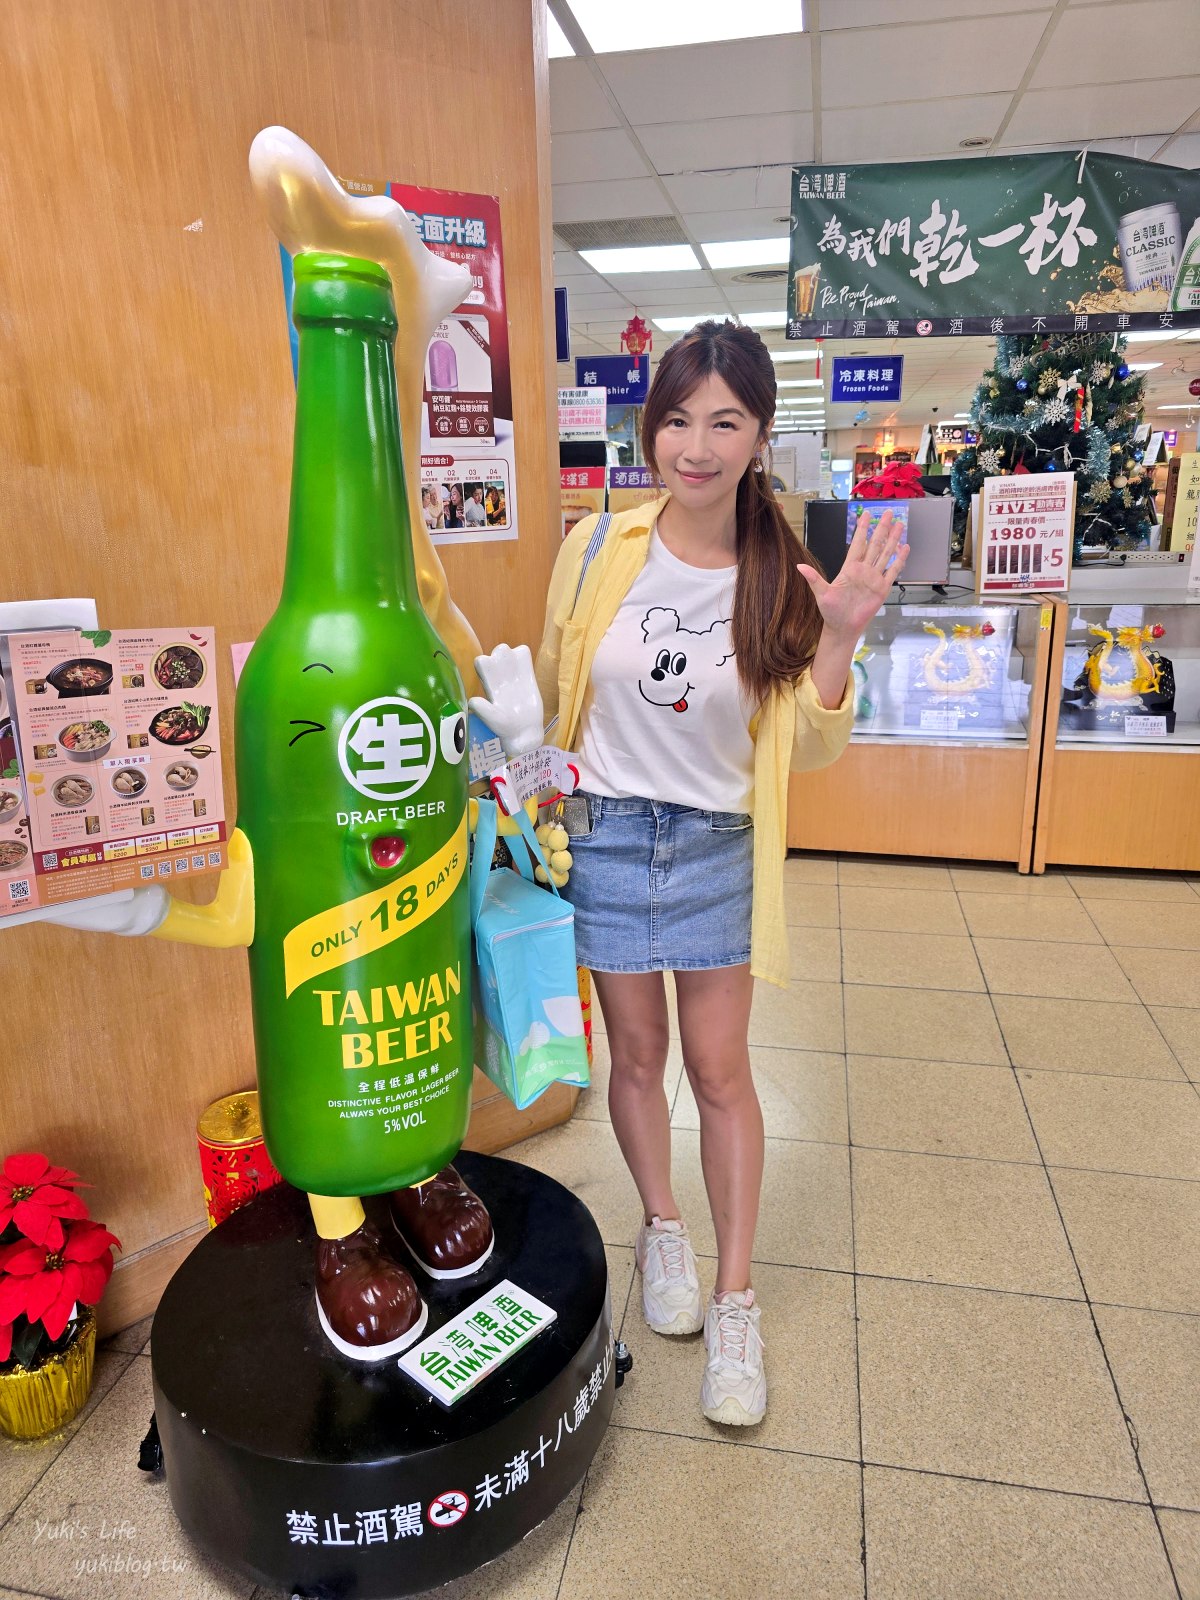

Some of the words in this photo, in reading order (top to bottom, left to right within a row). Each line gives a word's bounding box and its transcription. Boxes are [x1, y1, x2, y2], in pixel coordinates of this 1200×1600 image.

[826, 191, 846, 199] BEER
[1125, 235, 1176, 257] CLASSIC
[820, 285, 838, 308] Be
[840, 283, 869, 304] Proud
[789, 320, 899, 338] 禁止酒駕
[839, 368, 894, 383] 冷凍料理
[607, 387, 629, 395] shier
[842, 385, 866, 393] Frozen
[868, 384, 889, 392] Foods
[989, 501, 1036, 515] FIVE
[990, 527, 1036, 541] 1980
[348, 714, 427, 784] 生
[336, 807, 400, 826] DRAFT
[405, 801, 446, 819] BEER
[310, 920, 363, 958] ONLY
[370, 884, 419, 933] 18
[426, 852, 459, 898] DAYS
[313, 961, 461, 1026] TAIWAN
[342, 1011, 453, 1069] BEER
[328, 1097, 381, 1108] DISTINCTIVE
[386, 1089, 418, 1103] FLAVOR
[421, 1078, 444, 1093] LAGER
[444, 1068, 460, 1083] BEER
[358, 1063, 440, 1094] 全程低溫保鮮
[339, 1109, 374, 1119] ALWAYS
[377, 1105, 401, 1115] YOUR
[403, 1097, 423, 1110] BEST
[424, 1085, 450, 1103] CHOICE
[434, 1340, 502, 1390] TAIWAN
[493, 1309, 543, 1346] BEER
[286, 1502, 424, 1546] 禁止酒駕
[474, 1328, 615, 1512] 未滿十八歲禁止
